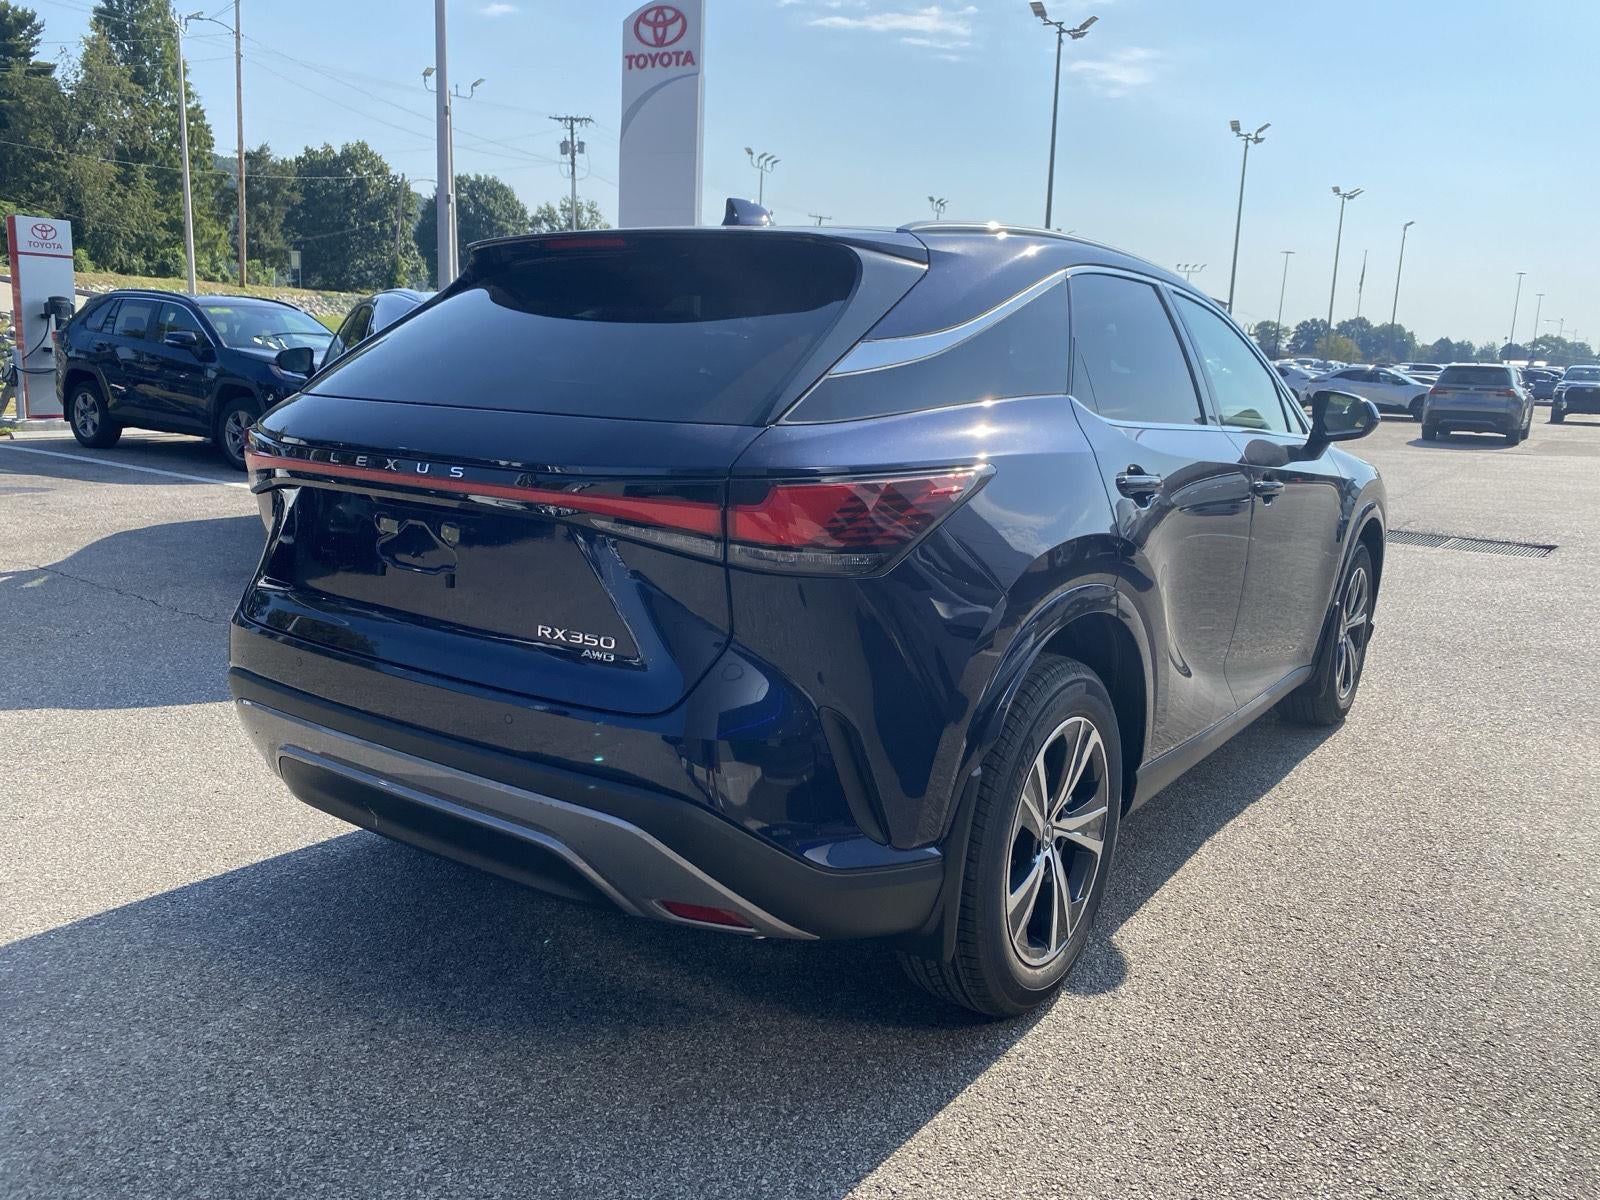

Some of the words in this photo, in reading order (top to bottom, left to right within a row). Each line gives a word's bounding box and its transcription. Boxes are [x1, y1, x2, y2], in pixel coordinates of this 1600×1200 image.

[625, 50, 696, 70] TOYOTA
[28, 240, 63, 250] TOYOTA
[329, 452, 464, 478] LEXUS
[537, 624, 615, 649] RX350
[581, 648, 615, 662] AWD
